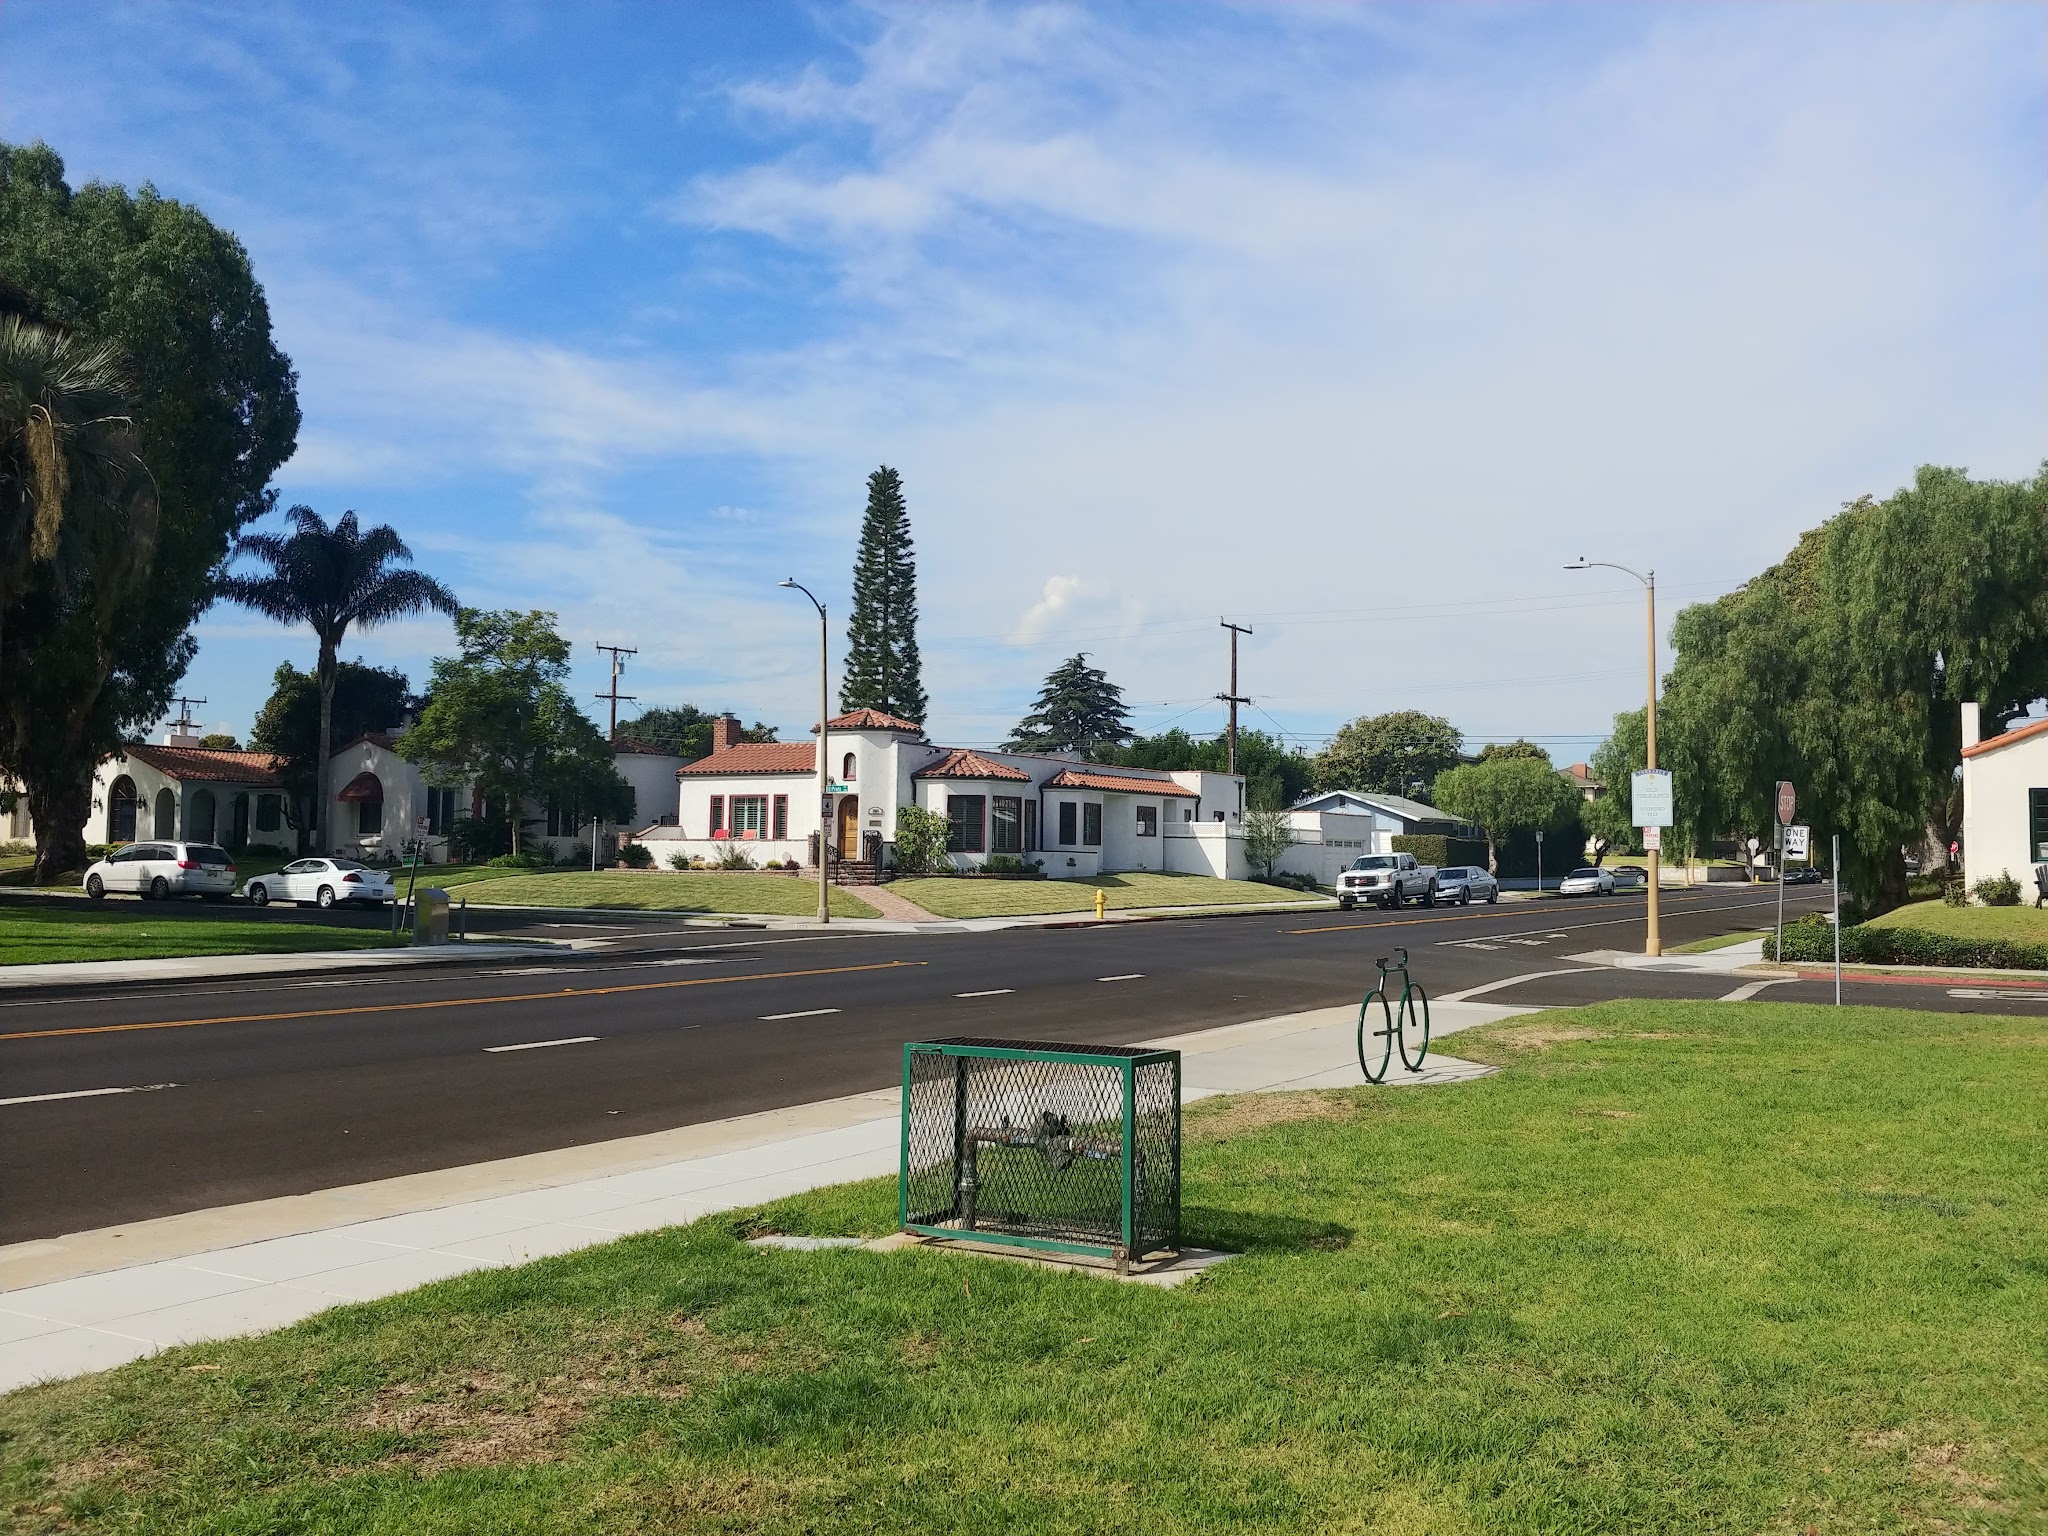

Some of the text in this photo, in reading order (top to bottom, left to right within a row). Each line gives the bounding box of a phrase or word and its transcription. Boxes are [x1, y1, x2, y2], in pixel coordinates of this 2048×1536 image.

[1780, 796, 1794, 811] STOP
[1786, 829, 1804, 837] ONE
[1785, 838, 1805, 847] WAY
